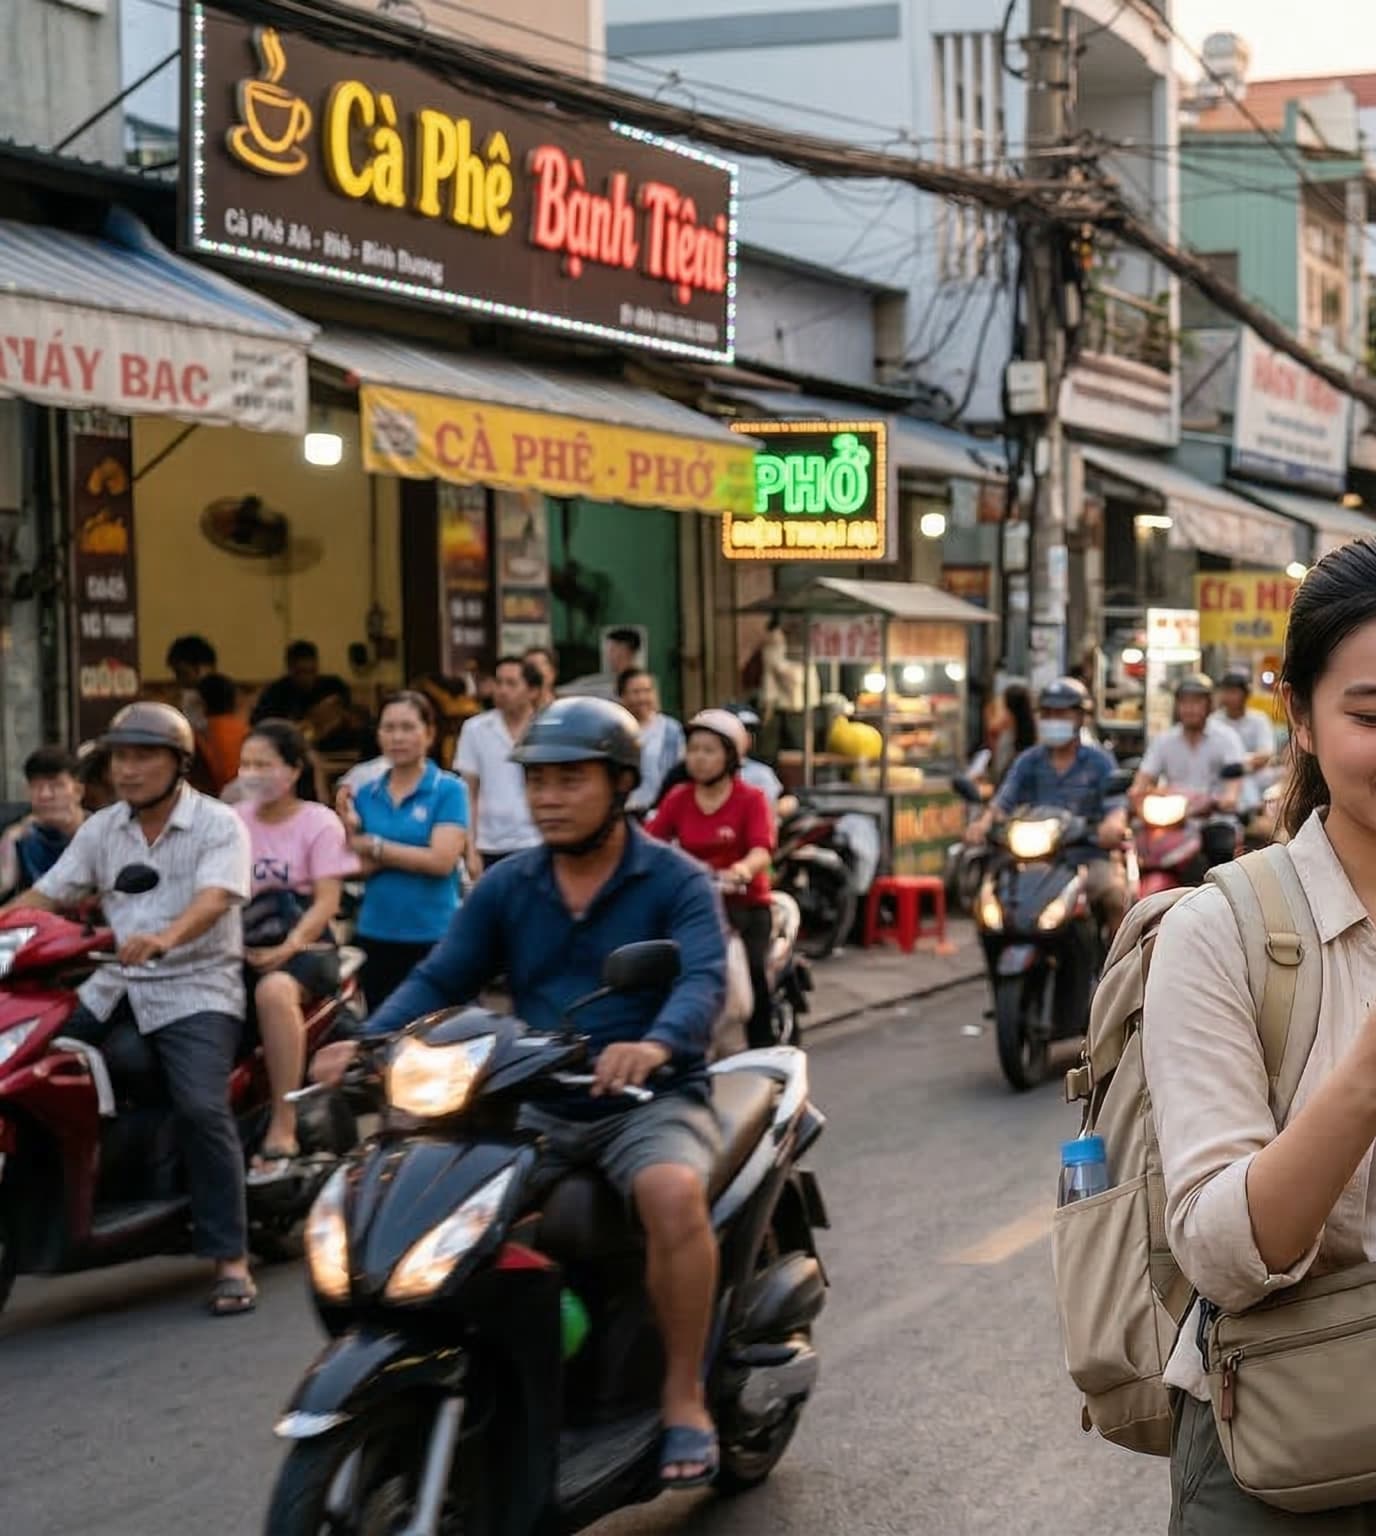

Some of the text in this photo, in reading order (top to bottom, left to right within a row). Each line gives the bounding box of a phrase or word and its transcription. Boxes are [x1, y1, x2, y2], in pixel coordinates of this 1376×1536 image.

[328, 80, 406, 208] Cà
[417, 108, 513, 236] Phê
[224, 207, 249, 237] Cà
[120, 352, 210, 407] BAC
[435, 412, 497, 473] CÀ
[512, 431, 596, 485] PHÊ
[627, 442, 716, 500] PHỞ
[754, 433, 871, 515] PHỞ
